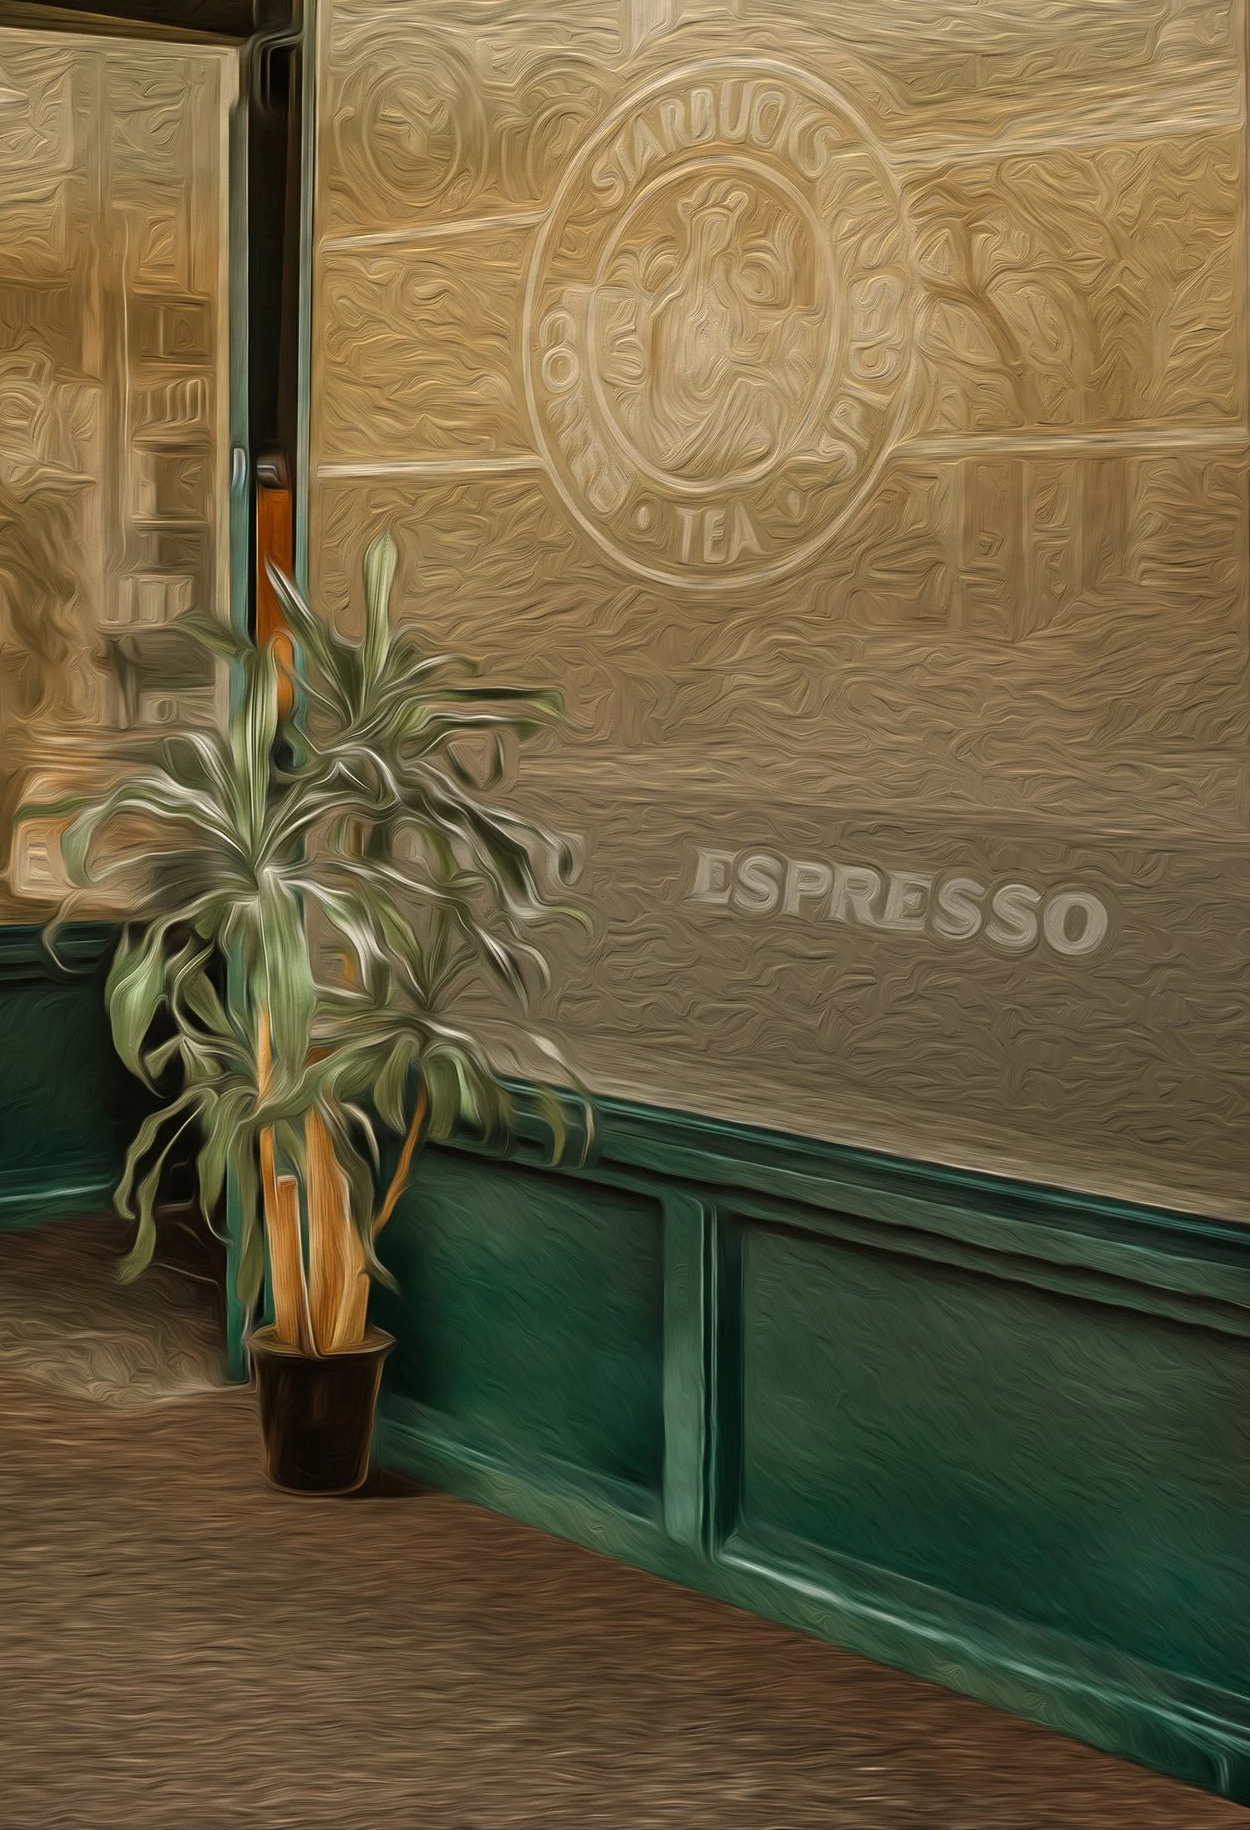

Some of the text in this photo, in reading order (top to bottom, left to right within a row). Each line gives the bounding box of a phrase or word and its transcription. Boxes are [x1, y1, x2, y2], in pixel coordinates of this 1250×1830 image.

[808, 273, 906, 482] SPICS
[674, 503, 766, 564] TEA
[683, 846, 1109, 956] ESPRESSO
